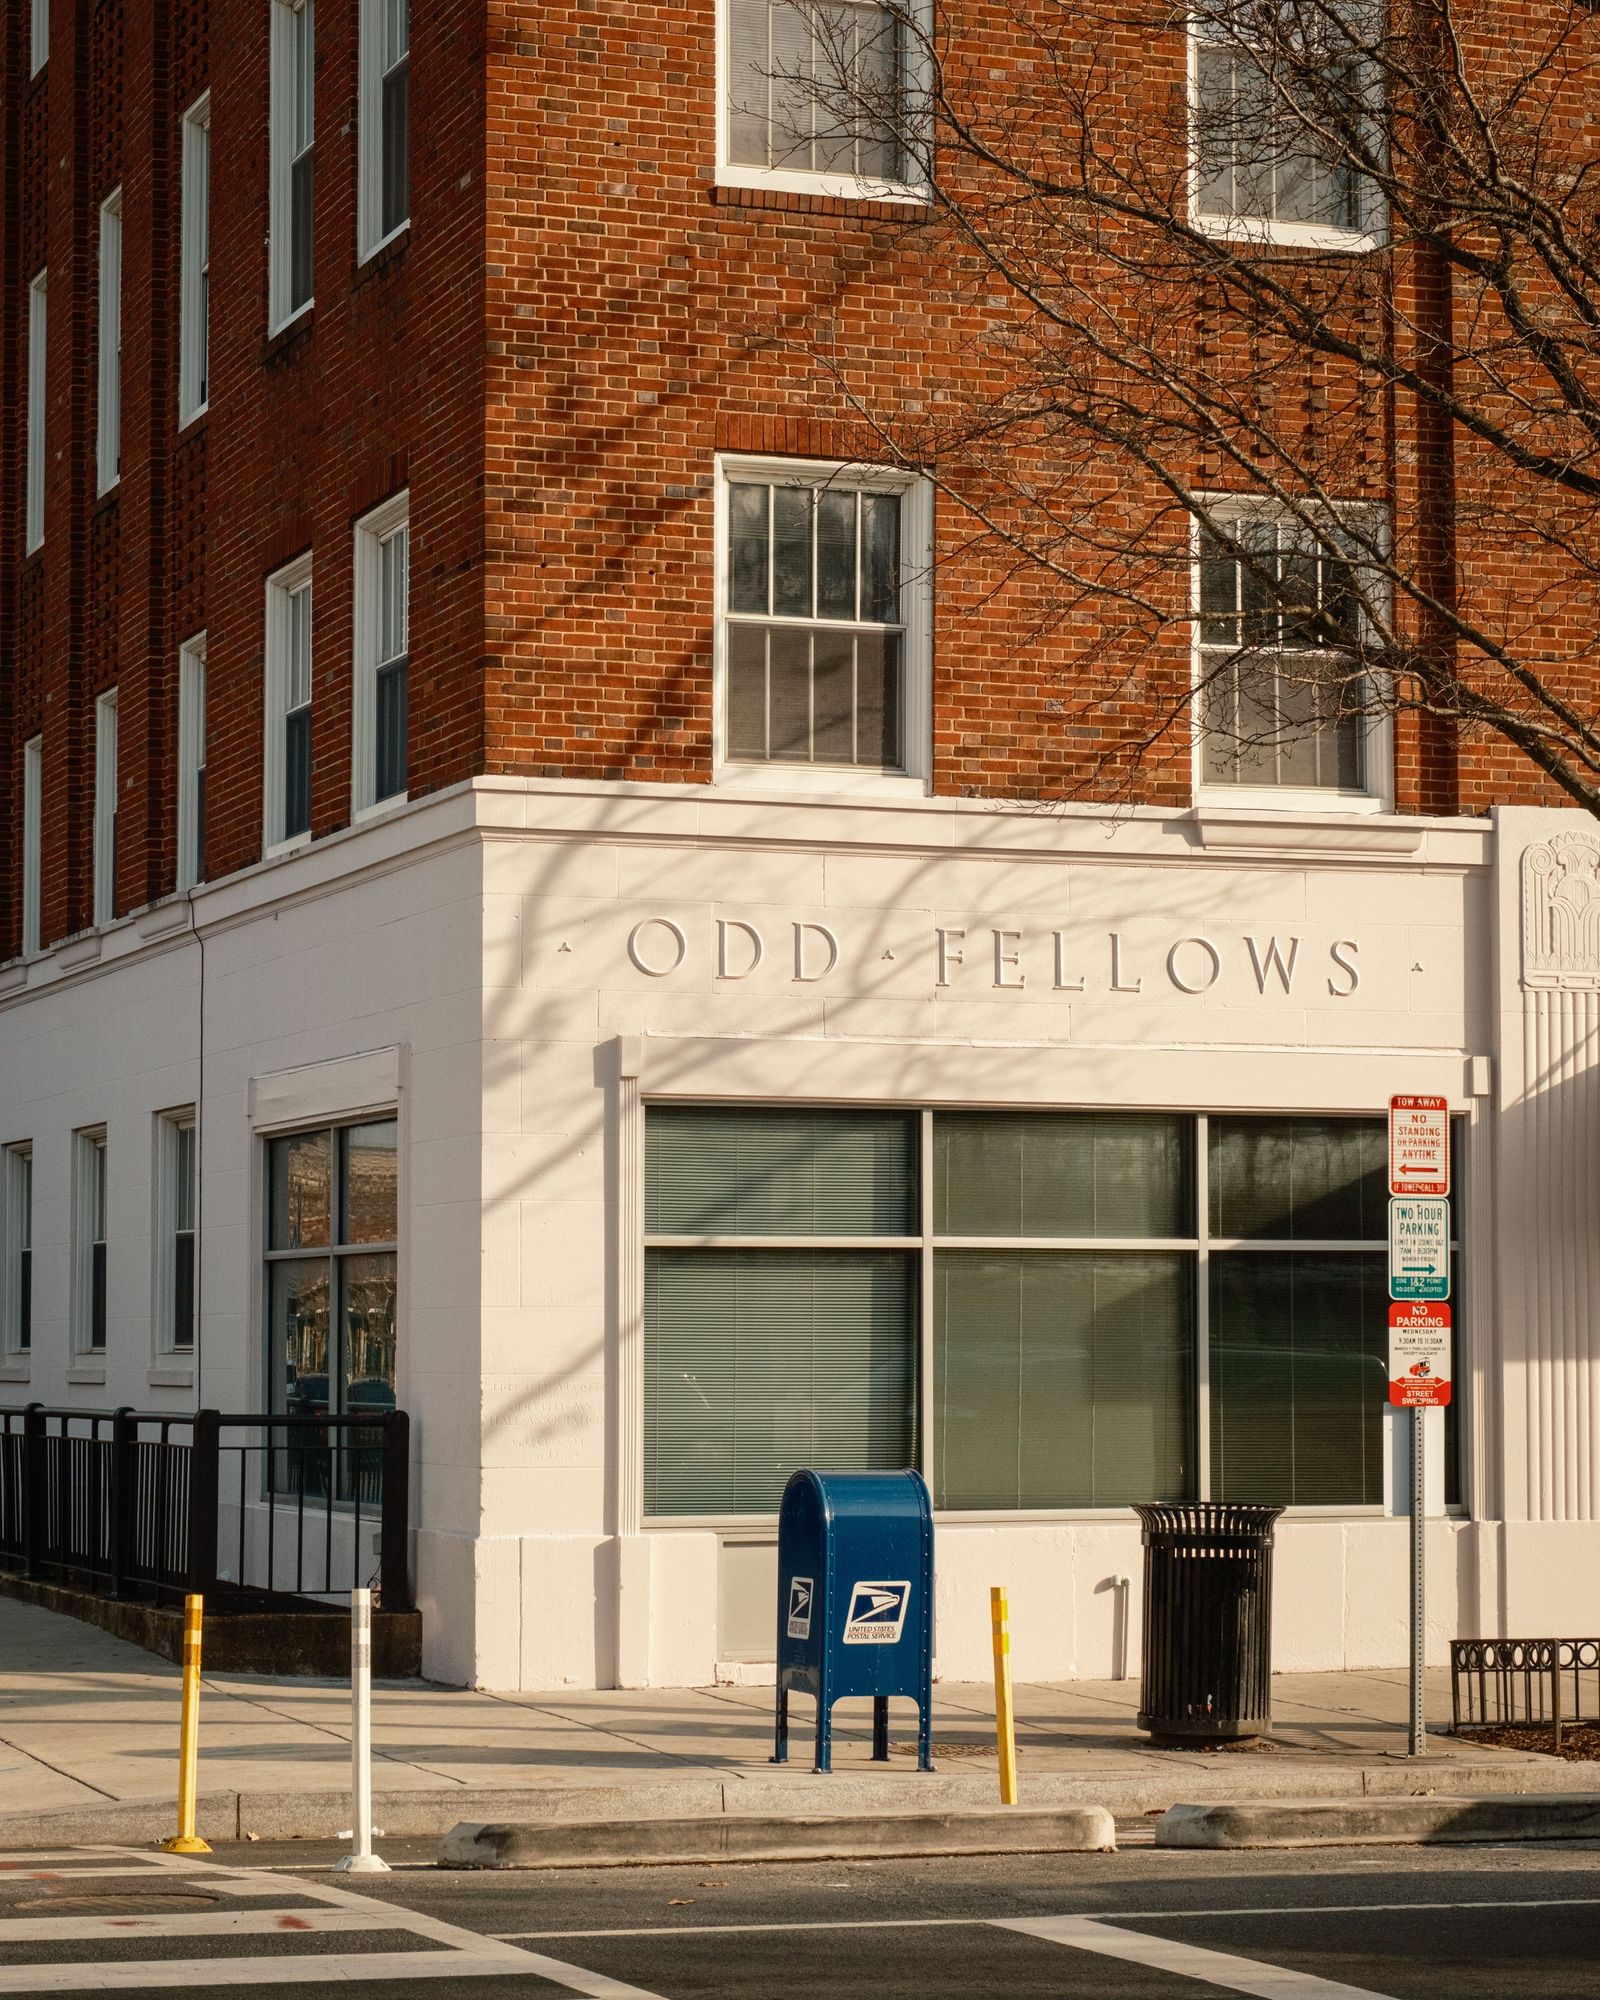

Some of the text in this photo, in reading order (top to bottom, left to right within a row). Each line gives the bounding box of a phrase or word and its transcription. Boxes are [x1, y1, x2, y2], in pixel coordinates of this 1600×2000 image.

[627, 917, 1360, 997] ODD FELLOWS
[1397, 1097, 1441, 1107] TOW AWAY
[1411, 1114, 1427, 1124] NO
[1398, 1126, 1440, 1137] STANDING
[1408, 1138, 1440, 1148] PARKING
[1402, 1149, 1437, 1160] ANYTIME
[1394, 1182, 1400, 1191] IF
[1396, 1207, 1443, 1221] TWO HOUR
[1399, 1222, 1439, 1236] PARKING
[1410, 1277, 1425, 1287] 1&2
[1412, 1305, 1428, 1316] NO
[1396, 1316, 1444, 1327] PARKING
